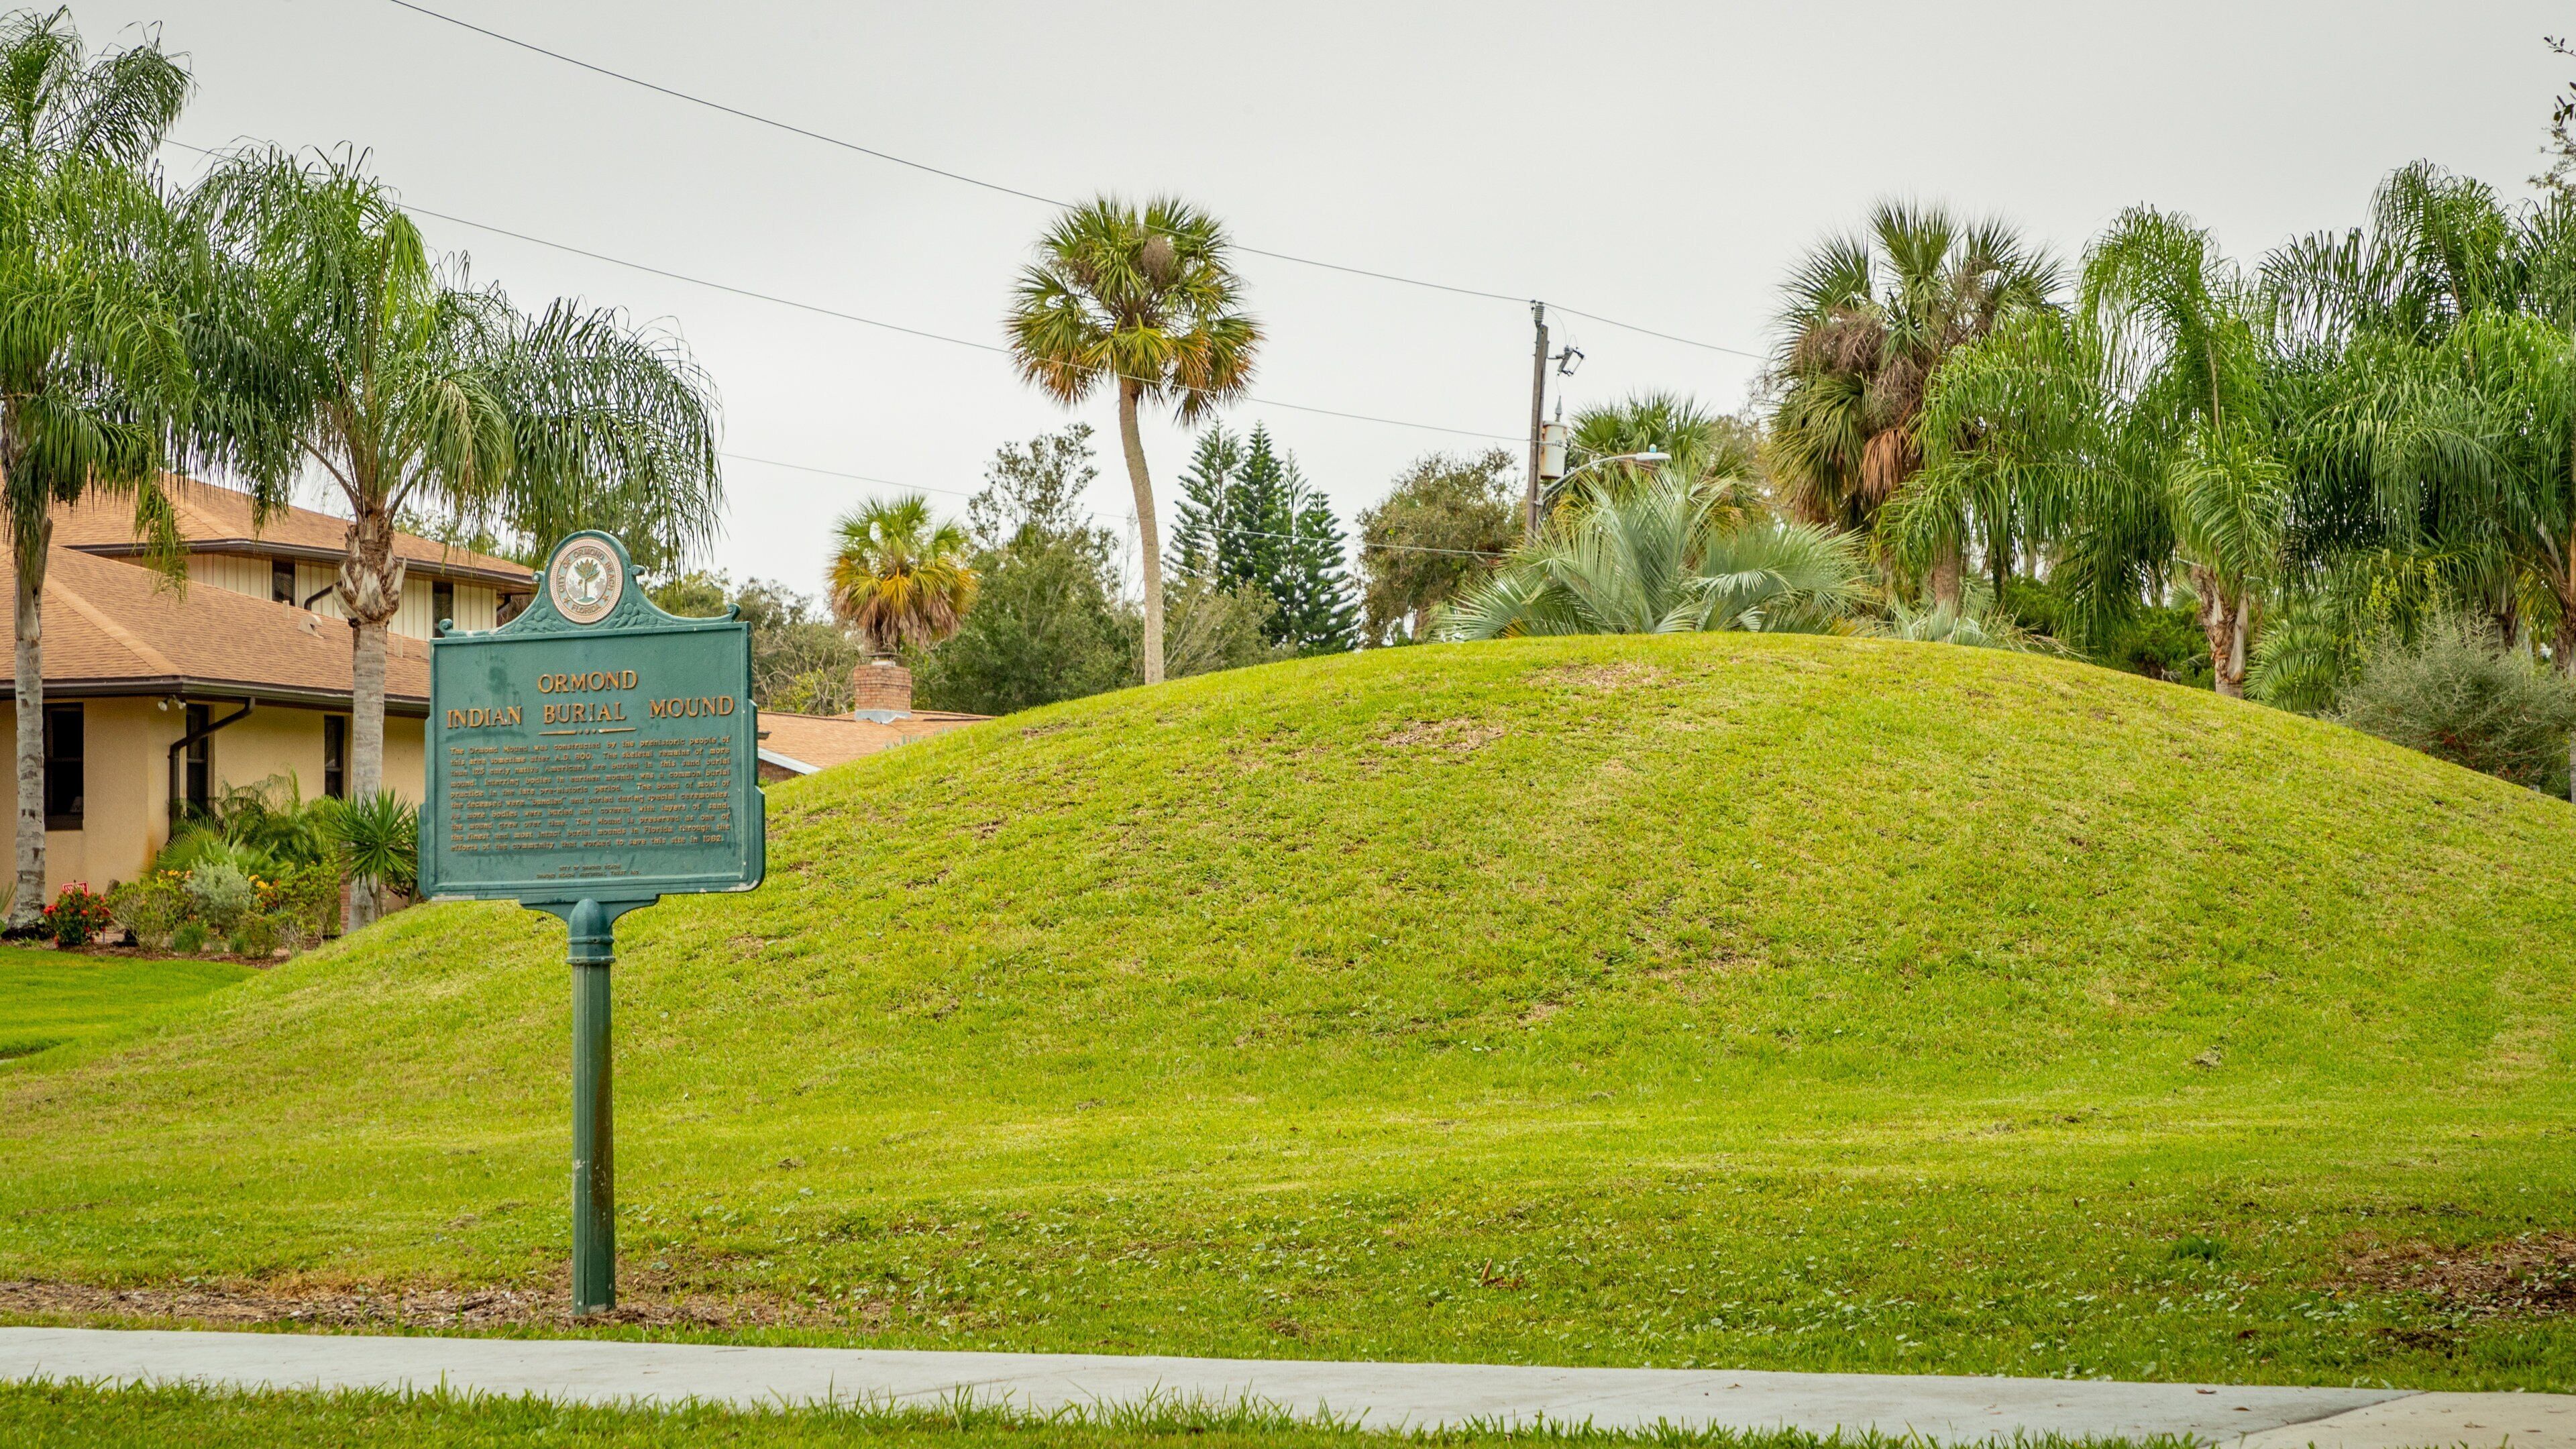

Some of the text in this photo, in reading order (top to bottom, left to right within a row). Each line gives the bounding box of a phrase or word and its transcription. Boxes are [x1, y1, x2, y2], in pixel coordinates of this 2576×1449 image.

[563, 558, 571, 570] OF
[574, 548, 605, 561] ORMOND
[605, 561, 615, 591] BEACH
[572, 604, 601, 614] FLORIDA
[537, 670, 639, 694] ORMOND
[446, 696, 735, 729] INDIAN BURIAL MOUND
[450, 747, 464, 755] The
[468, 746, 498, 754] Ormond
[553, 742, 600, 750] constructed
[640, 739, 685, 747] prehistoric
[690, 737, 716, 745] people
[450, 758, 465, 766] this
[490, 756, 526, 764] sometime
[530, 754, 550, 762] after
[622, 750, 653, 758] skeletal
[659, 749, 690, 757] remains
[490, 767, 511, 775] early
[545, 763, 586, 772] Americans
[612, 761, 639, 769] buried
[660, 759, 676, 767] this
[706, 757, 731, 765] burial
[525, 776, 551, 784] bodies
[606, 773, 635, 781] mounds
[706, 768, 731, 777] burial
[450, 790, 484, 798] practice
[657, 781, 680, 790] bones
[451, 801, 464, 809] the
[467, 799, 502, 808] deceased
[588, 795, 613, 804] buried
[619, 794, 644, 803] during
[647, 792, 676, 801] special
[451, 812, 461, 820] As
[467, 811, 485, 819] more
[548, 808, 573, 816] buried
[600, 806, 631, 814] covered
[661, 804, 686, 812] layers
[451, 823, 464, 831] the
[499, 821, 518, 830] grew
[598, 816, 623, 824] Mound
[628, 816, 635, 824] is
[639, 814, 680, 823] preserved
[720, 812, 731, 820] of
[451, 833, 464, 841] the
[467, 833, 490, 841] finest
[538, 830, 561, 838] intact
[568, 828, 592, 837] burial
[597, 827, 626, 835] mounds
[644, 825, 673, 833] Florida
[679, 824, 711, 833] through
[716, 822, 731, 830] the
[450, 843, 478, 852] efforts
[482, 843, 490, 851] of
[495, 842, 508, 850] the
[513, 841, 555, 849] community
[583, 839, 611, 847] worked
[629, 837, 646, 845] save
[651, 836, 666, 844] this
[671, 835, 686, 843] site
[691, 835, 698, 843] in
